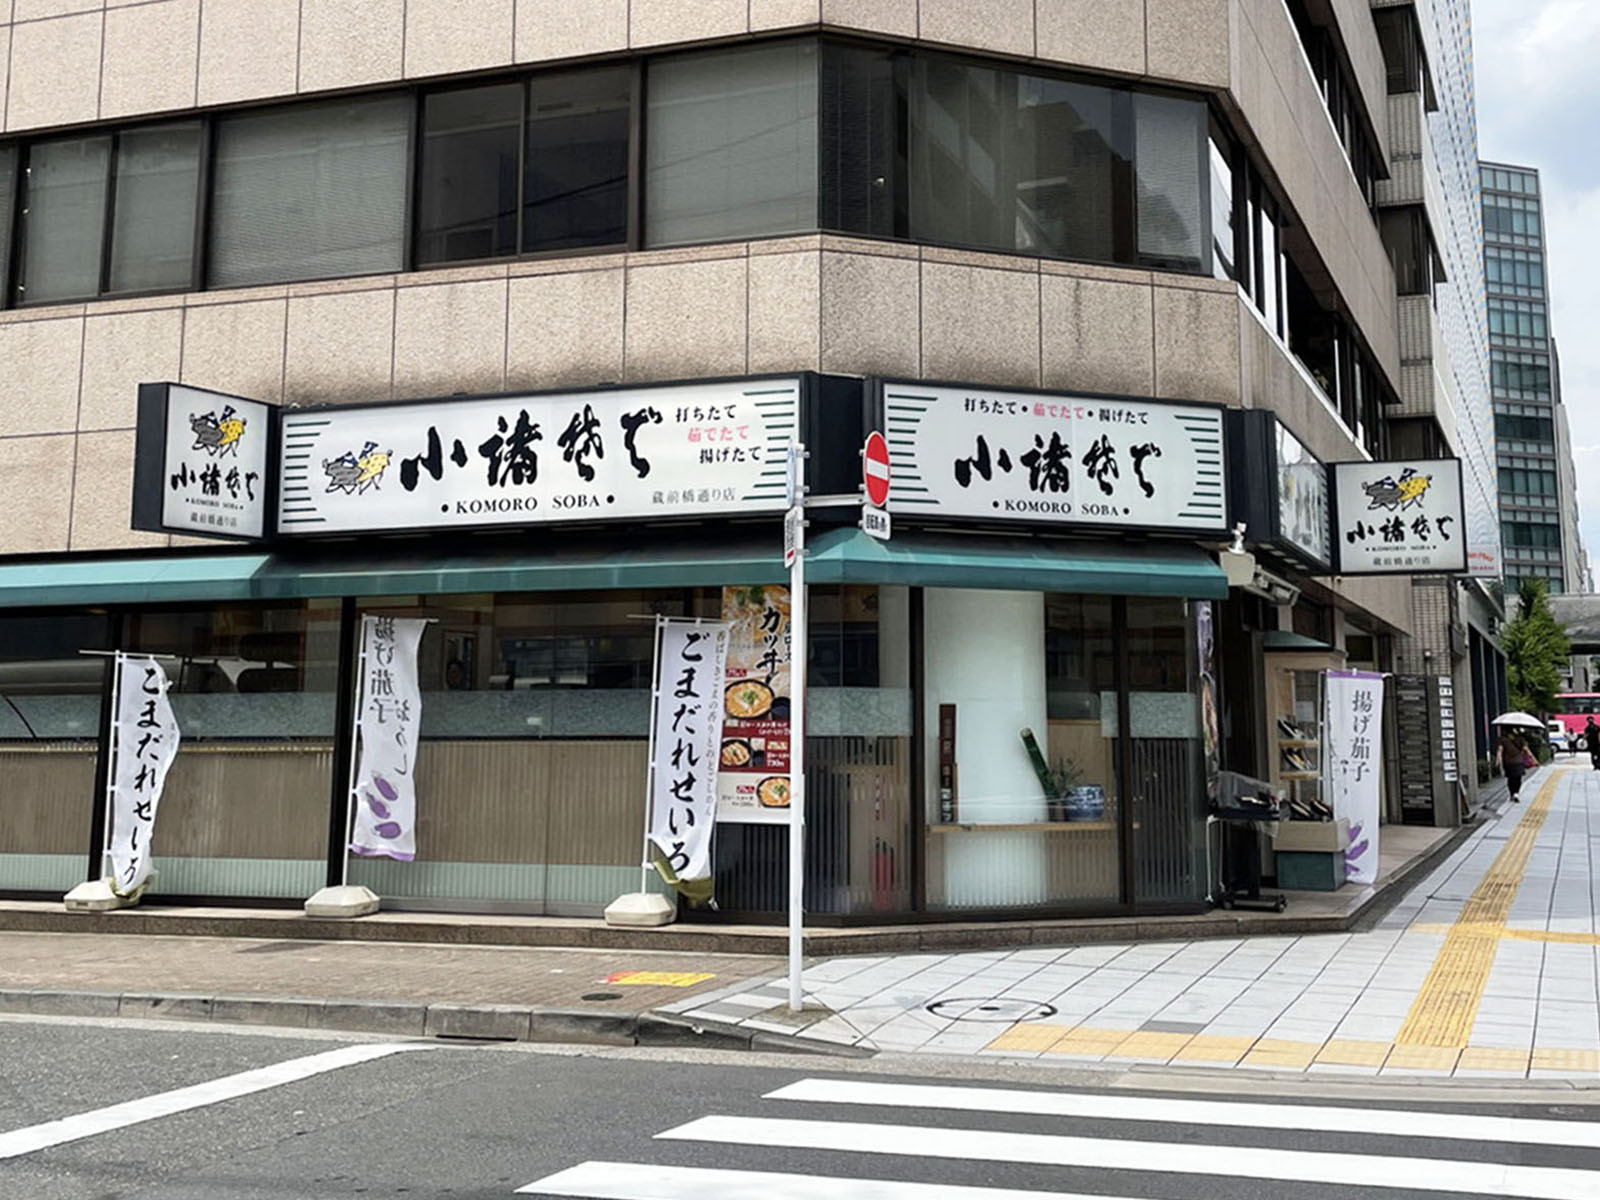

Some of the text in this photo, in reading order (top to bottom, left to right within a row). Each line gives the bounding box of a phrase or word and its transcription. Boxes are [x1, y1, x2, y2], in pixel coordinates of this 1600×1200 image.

[676, 404, 737, 423] 打ちたて
[965, 397, 1017, 415] 打ちたて
[1099, 408, 1149, 425] 揚げたて
[700, 446, 762, 464] 揚げたて
[456, 494, 600, 514] KOMORO SOBA
[1004, 499, 1119, 516] KOMORO SOBA
[1351, 690, 1373, 783] 揚げ茄子
[668, 632, 710, 873] ごまだれせいろ
